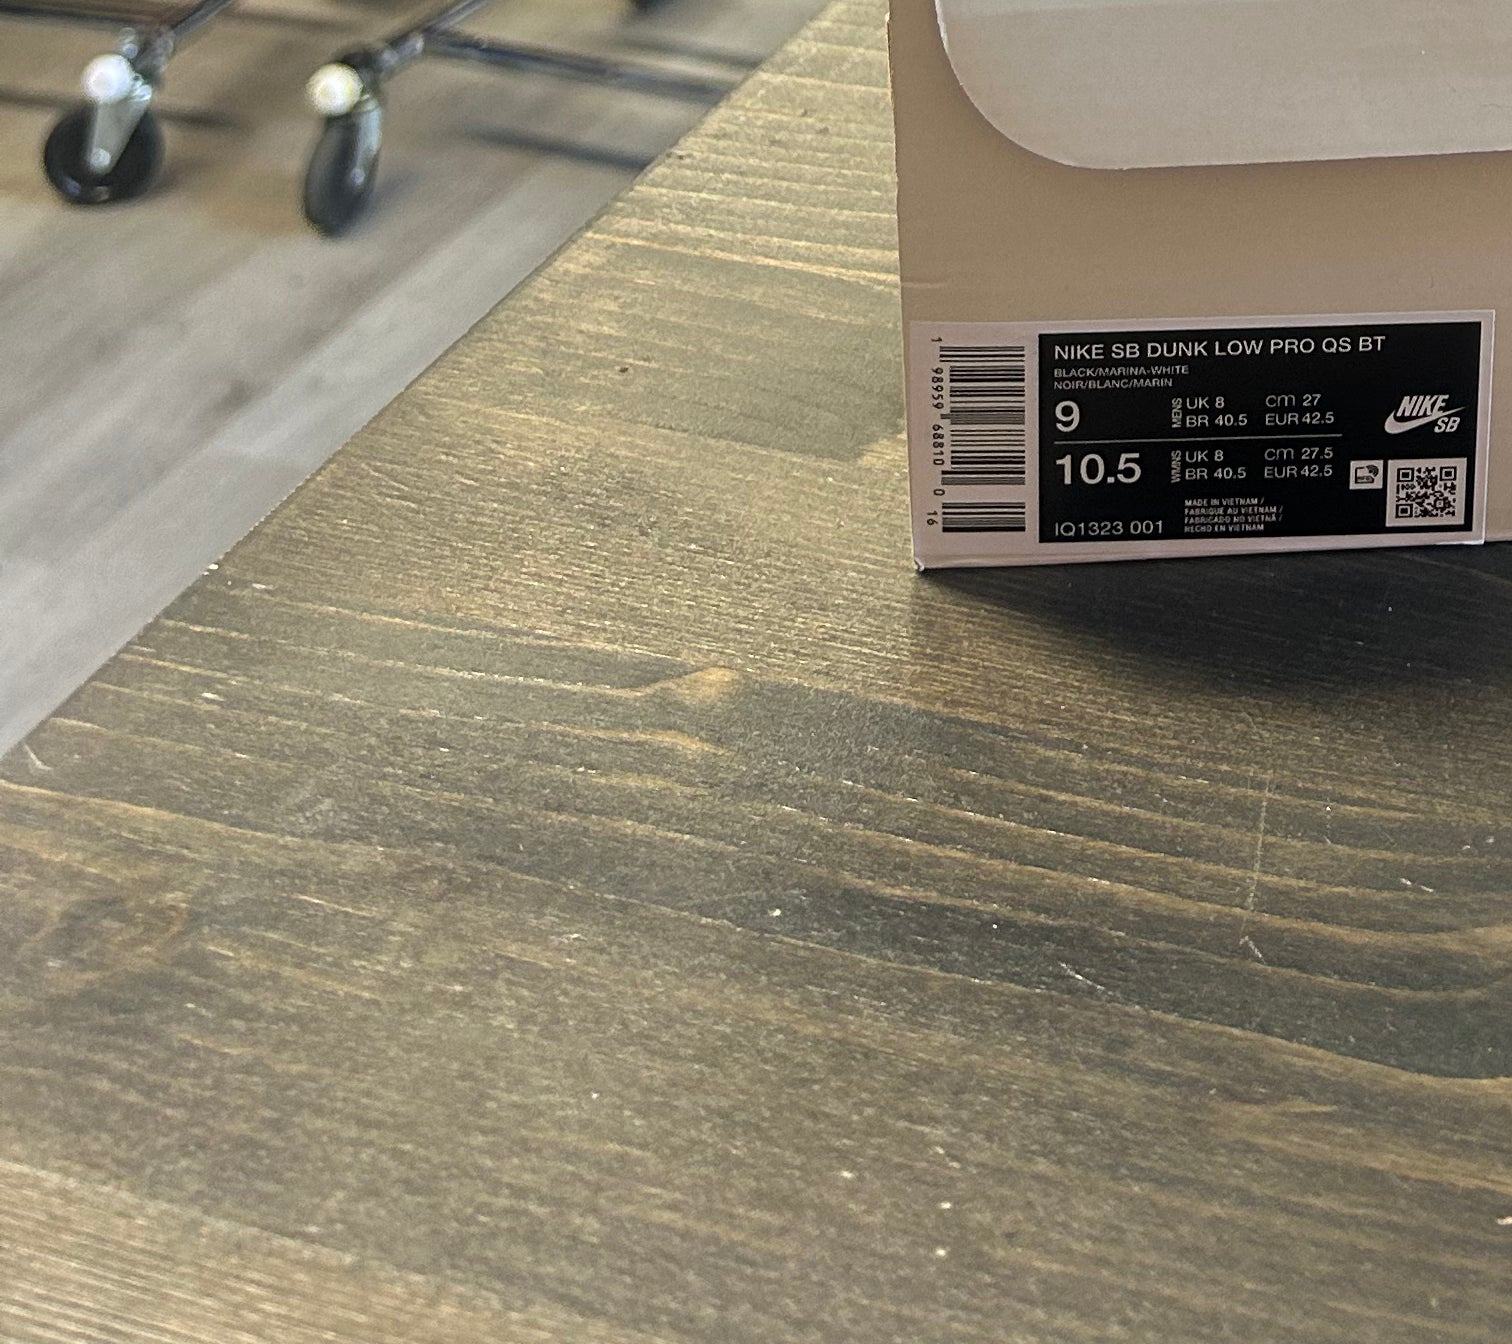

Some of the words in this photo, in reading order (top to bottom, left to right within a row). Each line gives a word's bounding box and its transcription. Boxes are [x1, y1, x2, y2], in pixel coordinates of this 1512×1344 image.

[1054, 343, 1105, 360] NIKE
[1111, 342, 1140, 359] SB
[1147, 341, 1208, 358] DUNK
[1214, 339, 1264, 356] LOW
[1270, 337, 1316, 355] PRO
[1321, 337, 1352, 353] QS
[1358, 336, 1386, 352] BT
[1053, 364, 1190, 378] BLACK/MARINA-WHITE
[931, 367, 944, 410] 98959
[1053, 377, 1174, 390] NOIR/BLANC/MARIN
[1186, 396, 1210, 409] UK
[1214, 396, 1225, 408] 8
[1265, 394, 1296, 407] cm
[1302, 394, 1322, 407] 27
[1396, 394, 1450, 417] NIKE
[1055, 400, 1080, 432] 9
[1171, 397, 1182, 428] MENS
[1265, 412, 1299, 426] EUR
[1301, 411, 1335, 425] 42.5
[1186, 415, 1209, 427] BR
[1214, 414, 1248, 427] 40.5
[1434, 416, 1461, 433] SB
[932, 424, 945, 466] 68810
[1185, 450, 1209, 463] UK
[1214, 449, 1224, 462] 8
[1264, 447, 1295, 461] cm
[1301, 447, 1334, 460] 27.5
[1055, 453, 1142, 485] 10.5
[1170, 450, 1182, 484] WMNS
[1185, 468, 1209, 480] BR
[1213, 467, 1247, 480] 40.5
[1264, 465, 1298, 479] EUR
[1300, 464, 1333, 478] 42.5
[1184, 498, 1209, 507] MADE
[1210, 498, 1220, 506] IN
[1221, 497, 1258, 506] VIETNAM
[1226, 507, 1238, 515] AU
[1241, 506, 1277, 514] VIETNAM
[1184, 515, 1231, 524] FABRICADO
[1233, 515, 1246, 524] NO
[1055, 521, 1124, 537] IQ1323
[1129, 520, 1163, 535] 001
[1184, 524, 1213, 533] HECHO
[1214, 524, 1226, 532] EN
[1228, 523, 1265, 532] VIETNAM
